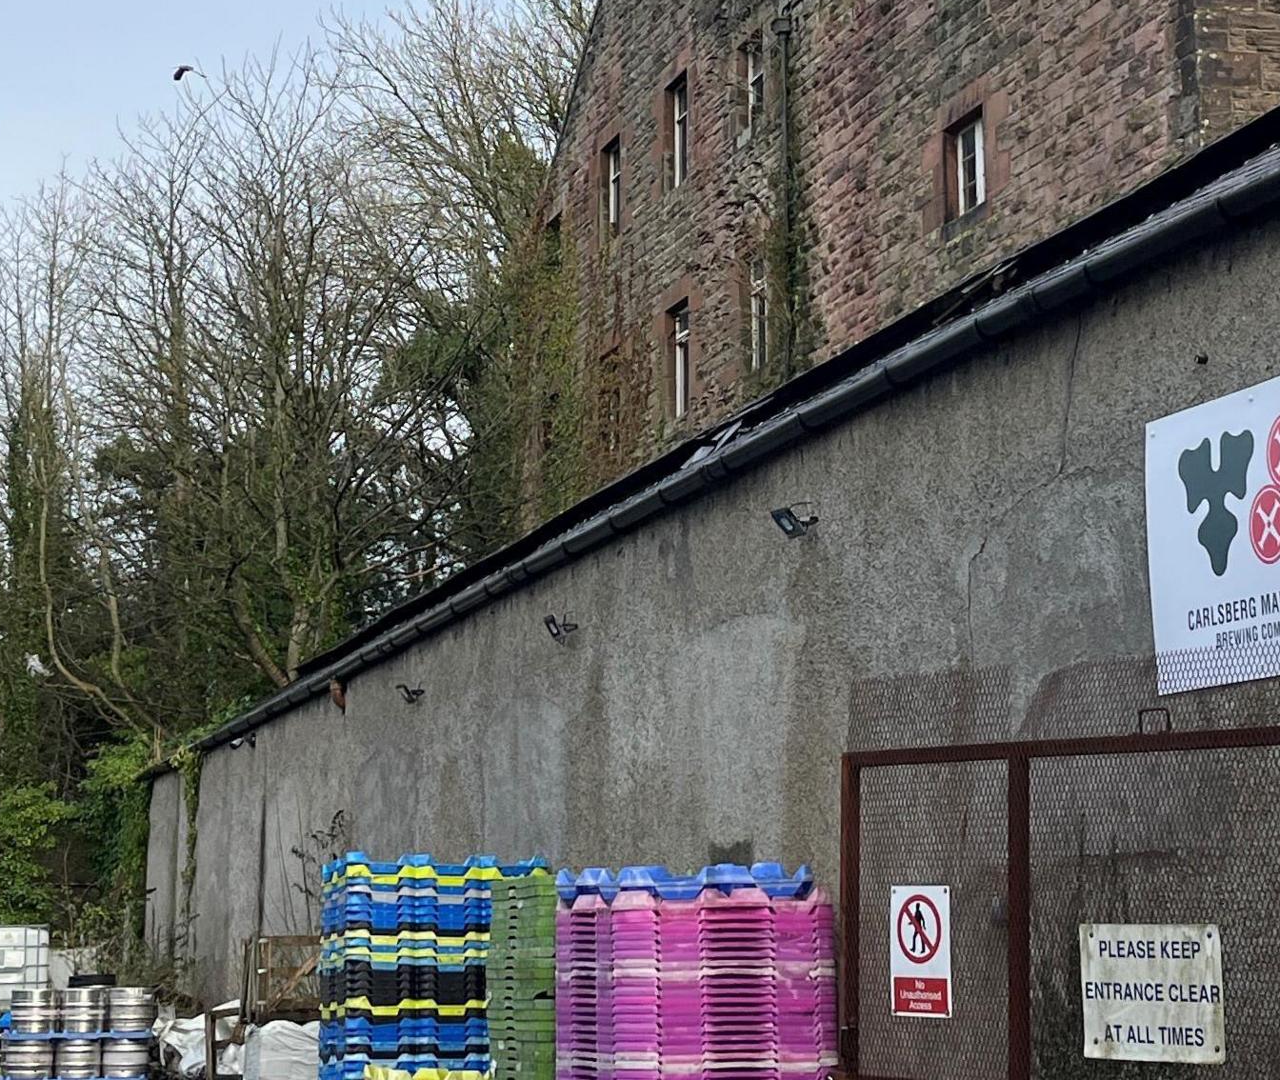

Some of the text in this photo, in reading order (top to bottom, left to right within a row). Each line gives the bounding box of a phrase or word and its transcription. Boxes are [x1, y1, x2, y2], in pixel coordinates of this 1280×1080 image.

[1187, 596, 1257, 631] CARLSBERG
[1215, 625, 1258, 649] BREWING
[1099, 940, 1201, 959] PLEASE KEEP
[914, 979, 925, 990] No
[1085, 981, 1220, 1003] ENTRANCE CLEAR
[1104, 1024, 1204, 1047] AT ALL TIMES
